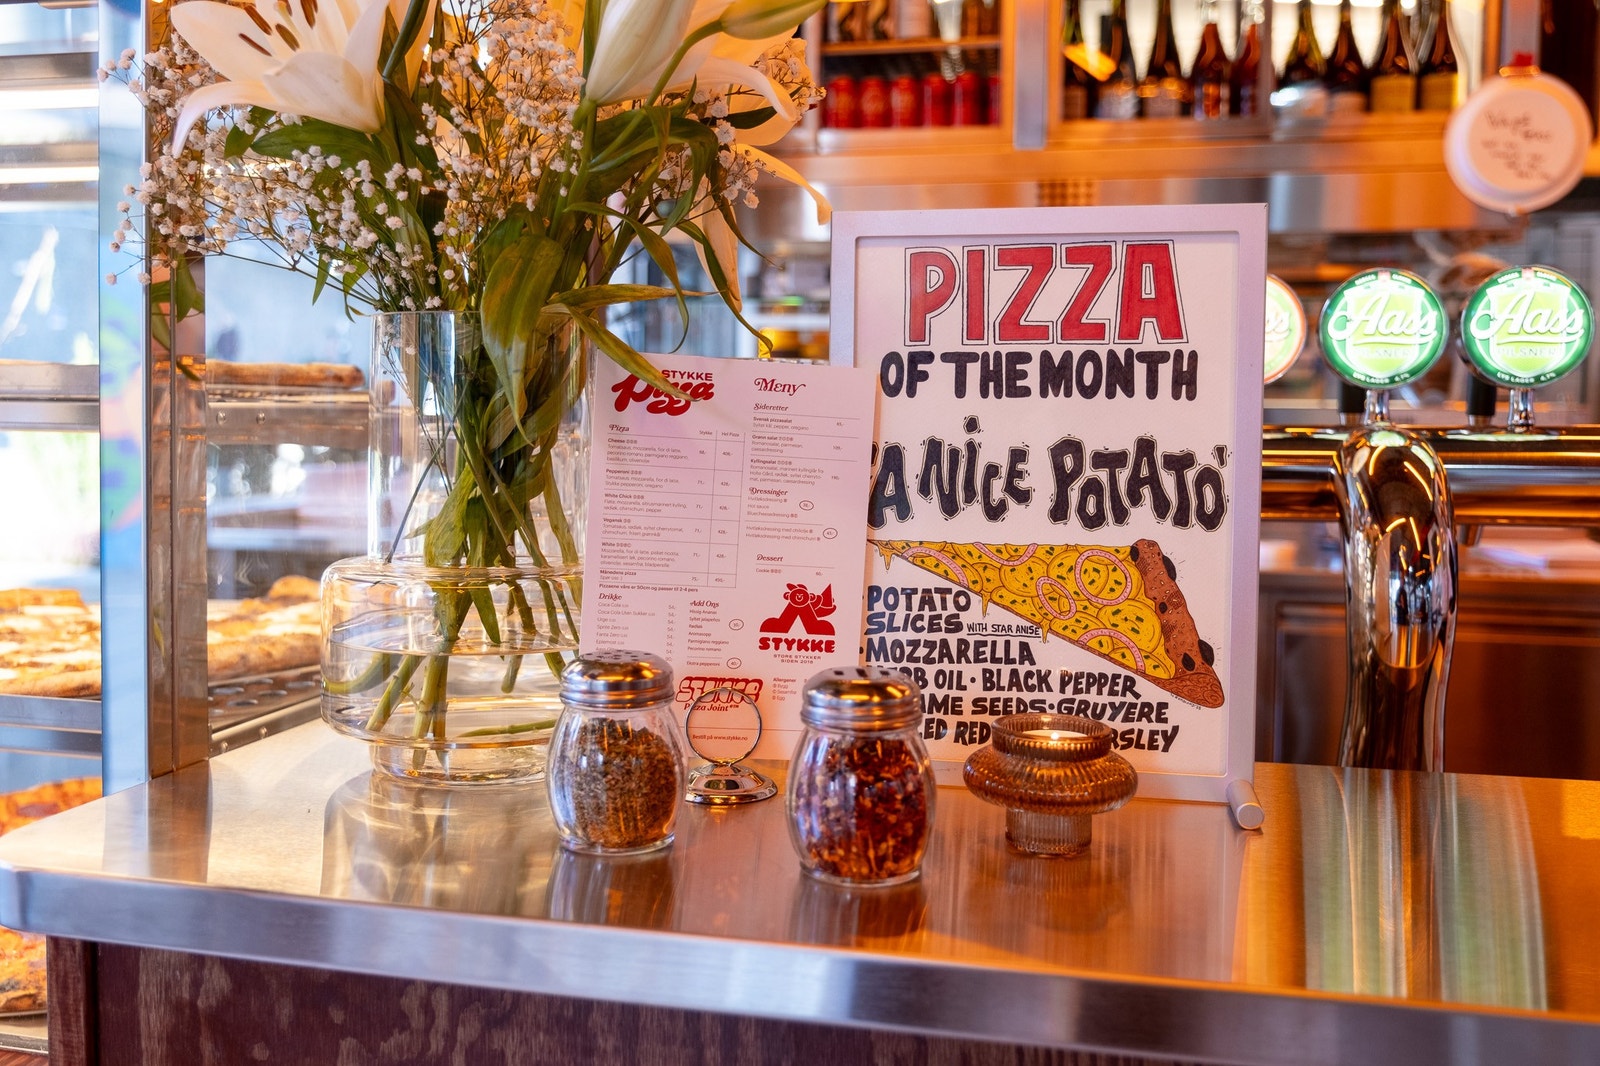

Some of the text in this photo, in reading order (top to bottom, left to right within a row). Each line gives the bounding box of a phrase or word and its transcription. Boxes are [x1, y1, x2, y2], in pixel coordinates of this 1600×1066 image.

[904, 240, 1189, 346] PIZZA
[1328, 290, 1438, 344] Aass
[1470, 289, 1585, 343] Aass
[662, 370, 713, 381] STYKKE
[880, 348, 1198, 401] OF THE MONTH
[754, 377, 806, 396] Meny
[609, 424, 629, 433] Pizza
[749, 487, 788, 497] Dressinger
[757, 554, 783, 562] Dessert
[599, 593, 622, 601] Drikke
[706, 600, 719, 608] Ons
[867, 585, 971, 612] POTATO
[865, 613, 1040, 636] SLICES WITH STAR ANISE
[758, 637, 835, 653] STYKKE
[865, 636, 1037, 666] MOZZARELLA
[934, 669, 967, 691] OIL
[982, 668, 1054, 692] BLACK
[1059, 670, 1142, 700] PEPPER
[707, 703, 728, 712] Joint
[1057, 698, 1169, 723] GRUYERE
[953, 721, 992, 745] RED
